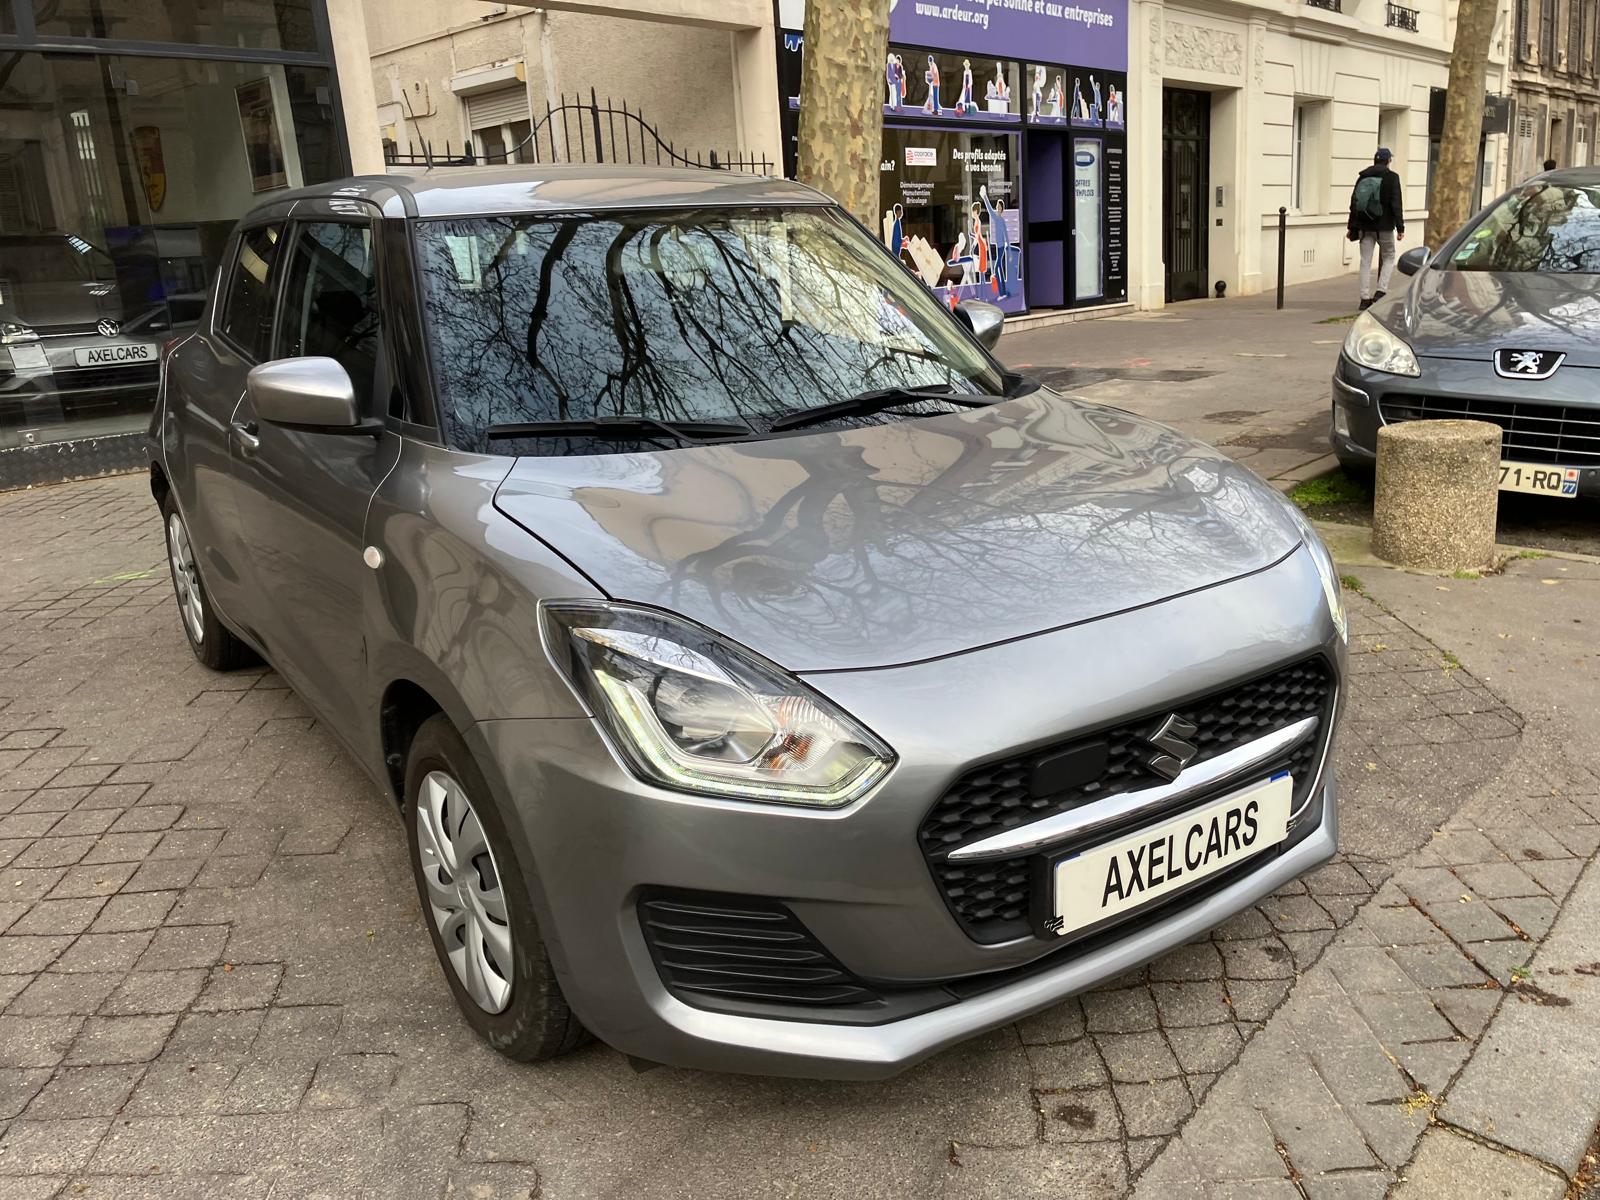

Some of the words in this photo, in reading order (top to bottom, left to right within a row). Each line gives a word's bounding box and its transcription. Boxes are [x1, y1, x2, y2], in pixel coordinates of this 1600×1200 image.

[915, 2, 989, 29] www.ardeur.org
[986, 0, 1033, 12] personne
[1034, 2, 1045, 15] et
[1046, 5, 1062, 18] aux
[1064, 6, 1113, 28] entreprises
[880, 159, 895, 171] ain?
[952, 148, 964, 160] Des
[964, 148, 984, 163] profils
[984, 149, 1006, 165] adaptés
[965, 161, 970, 171] à
[980, 161, 1001, 171] besoins
[906, 197, 928, 205] Bricolage
[87, 346, 148, 364] AXELCARS
[1499, 466, 1562, 491] 71-RQ
[1563, 482, 1576, 493] 77
[1101, 800, 1259, 908] AXELCARS
